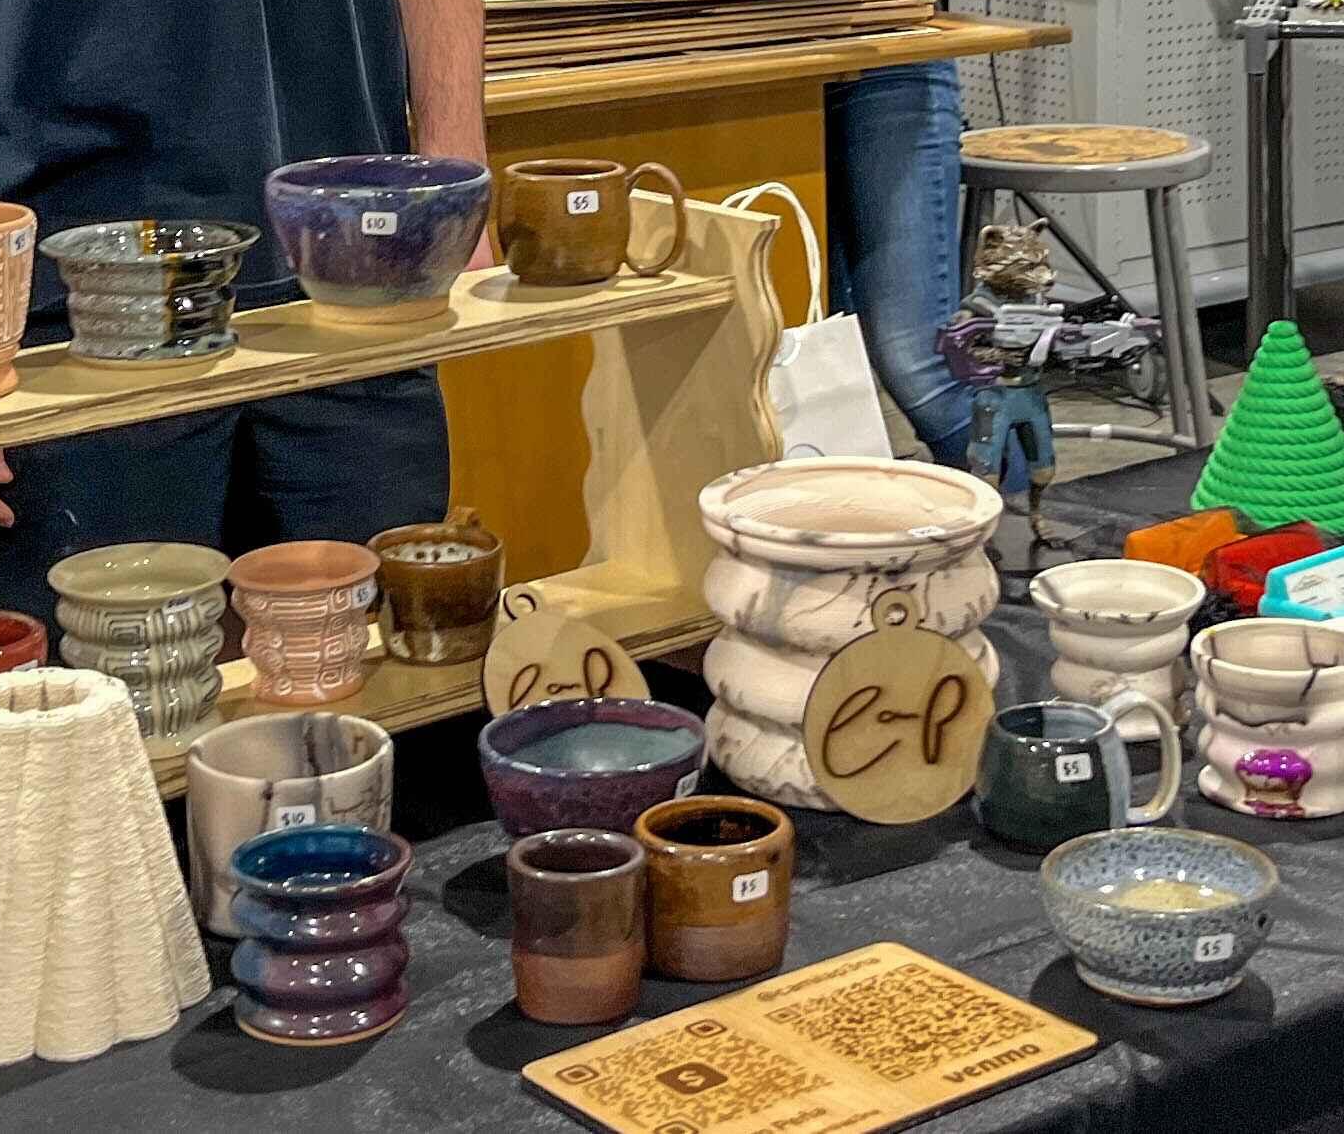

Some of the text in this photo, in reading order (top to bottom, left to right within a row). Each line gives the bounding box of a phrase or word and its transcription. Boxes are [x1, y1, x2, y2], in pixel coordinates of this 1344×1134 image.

[573, 194, 590, 211] $5
[366, 216, 386, 230] $10
[1063, 760, 1080, 777] $5
[281, 811, 306, 827] $10
[741, 877, 758, 898] $5
[1200, 938, 1222, 957] $5
[942, 1043, 1041, 1083] venmo
